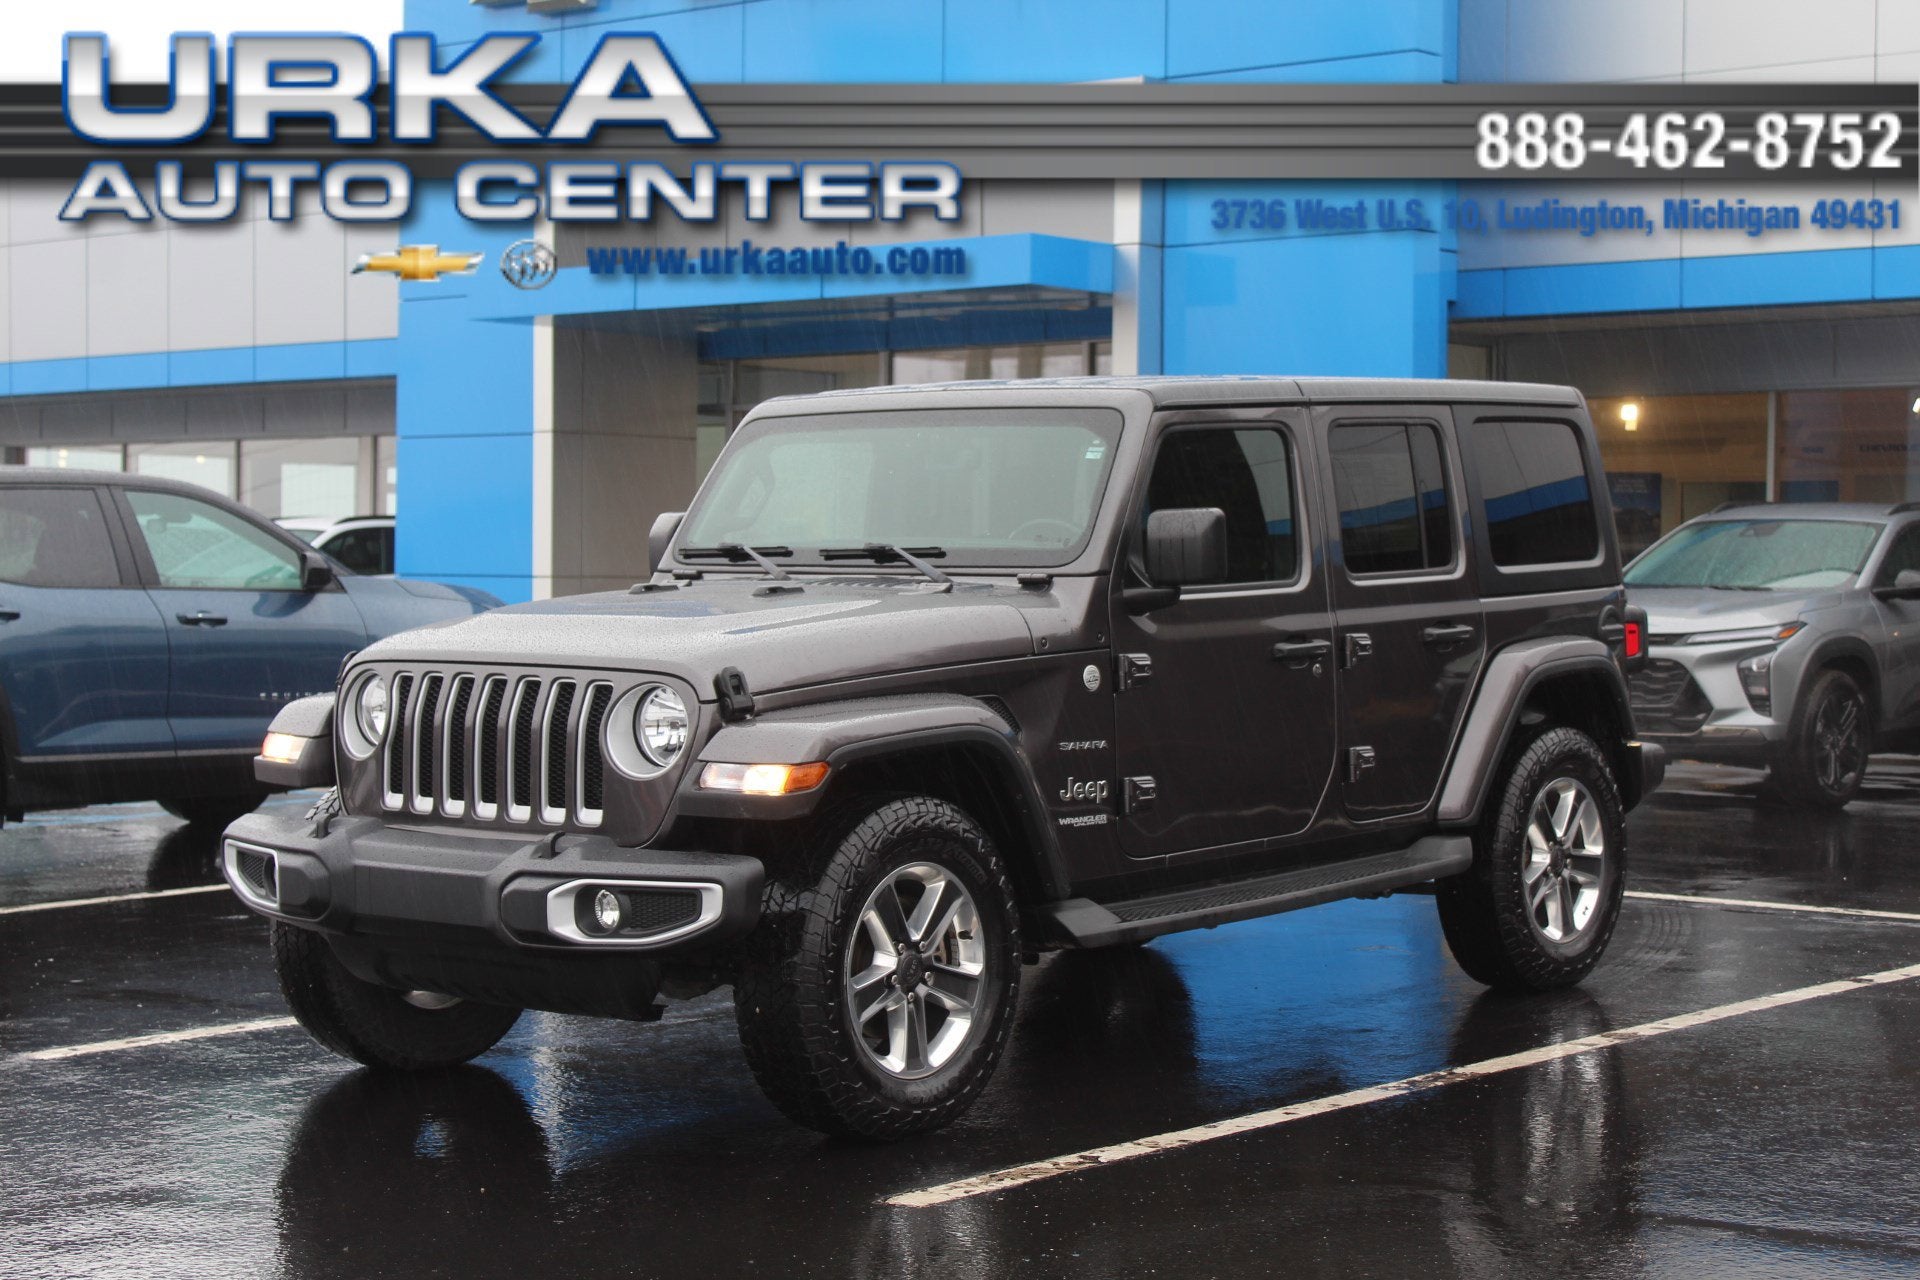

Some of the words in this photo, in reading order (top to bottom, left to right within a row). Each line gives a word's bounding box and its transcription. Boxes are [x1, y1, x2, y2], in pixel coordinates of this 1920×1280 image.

[1059, 740, 1108, 751] SAHARA
[1059, 777, 1108, 804] Jeep
[1058, 814, 1107, 825] WRANGLER
